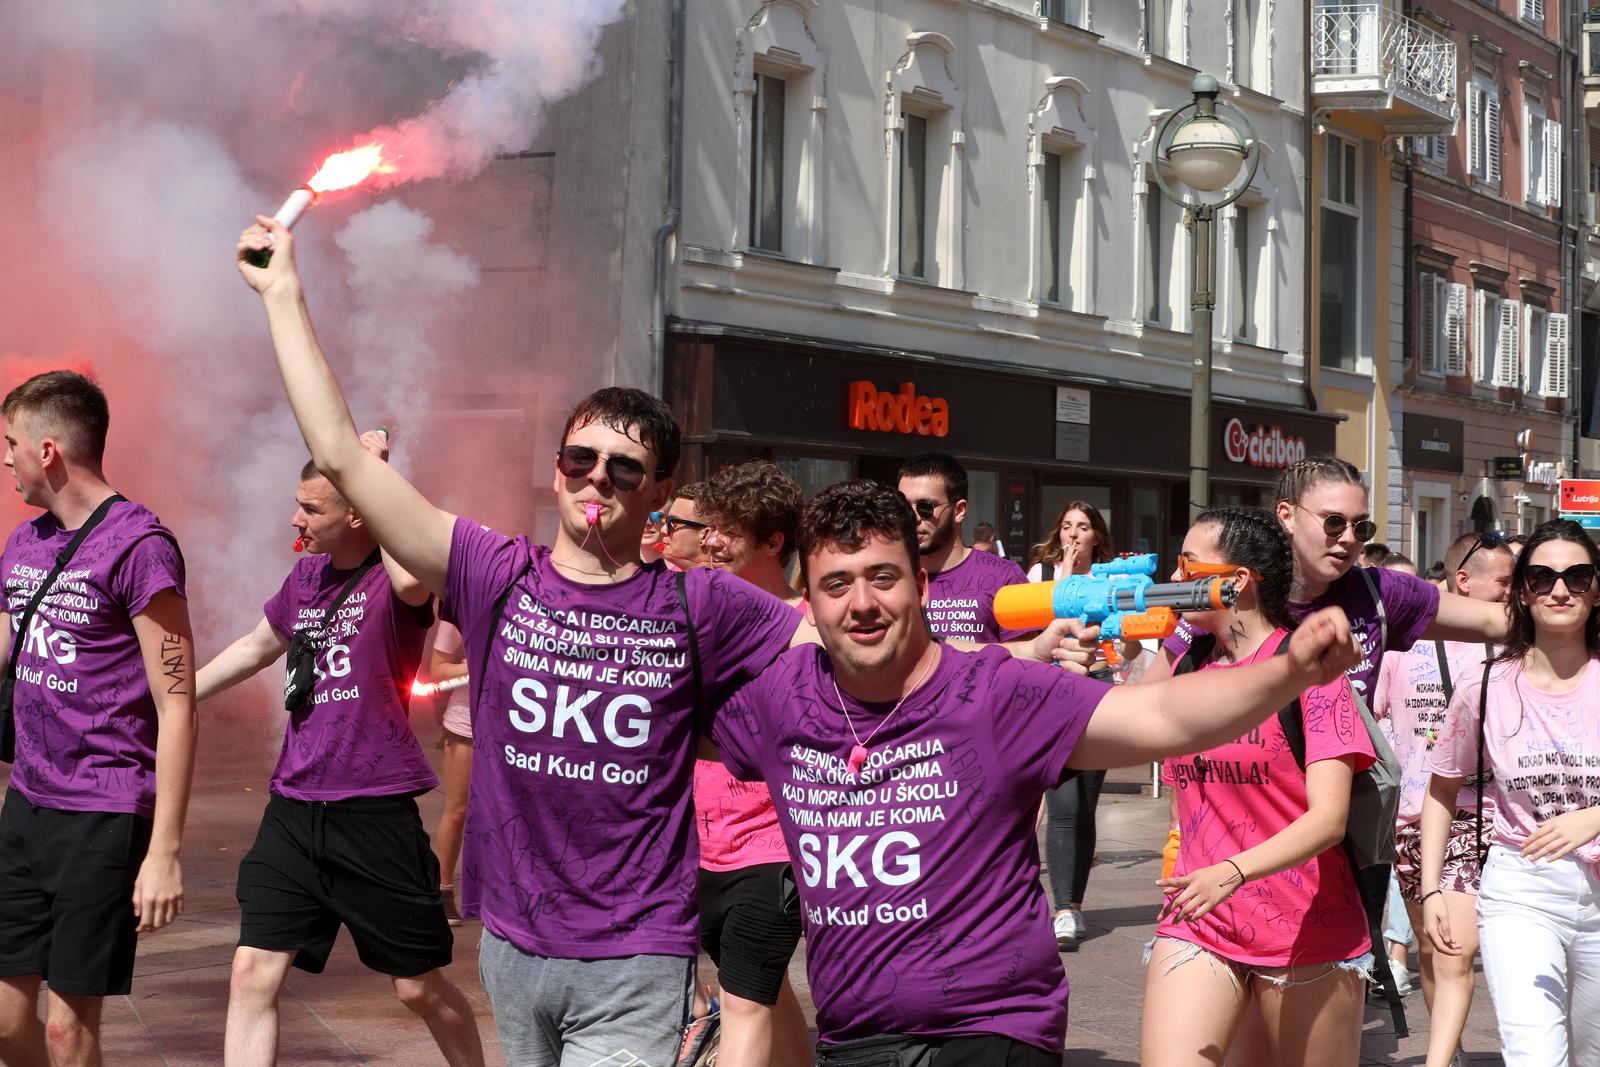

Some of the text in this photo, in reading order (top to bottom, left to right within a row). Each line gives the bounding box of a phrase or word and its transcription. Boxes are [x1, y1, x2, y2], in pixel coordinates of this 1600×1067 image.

[849, 380, 949, 437] Rodea
[1249, 425, 1306, 468] ciciban
[1572, 495, 1599, 504] Lutrija
[11, 564, 48, 580] SJENICA
[62, 593, 98, 610] ŠKOLU
[931, 597, 979, 609] BOĆARIJA
[58, 608, 90, 624] KOMA
[581, 612, 587, 627] I
[590, 614, 677, 634] BOĆARIJA
[932, 611, 977, 621] SU DOMA
[941, 623, 948, 632] U
[950, 621, 984, 633] ŠKOLU
[512, 613, 676, 648] NAŠA DVA SU DOMA
[501, 622, 686, 668] KAD MORAMO U ŠKOLU
[161, 632, 188, 695] MATE
[503, 646, 673, 688] SVIMA NAM JE KOMA
[22, 666, 43, 685] Kud
[47, 673, 78, 693] God
[1416, 683, 1435, 693] NIKAD
[331, 685, 360, 701] God
[508, 677, 652, 748] SKG
[1418, 713, 1428, 722] SAD
[504, 744, 649, 785] Sad Kud God
[790, 743, 848, 773] SJENICA
[1518, 754, 1543, 768] NIKAD
[792, 762, 826, 784] NAŠA
[860, 769, 884, 785] SU
[889, 761, 943, 781] DOMA
[1204, 759, 1270, 785] HVALA!
[782, 782, 805, 803] KAD
[808, 788, 877, 806] MORAMO
[880, 788, 892, 804] U
[896, 780, 958, 802] ŠKOLU
[788, 805, 946, 828] SVIMA NAM JE KOMA
[799, 830, 921, 889] SKG
[827, 904, 869, 926] Kud
[875, 898, 928, 924] God
